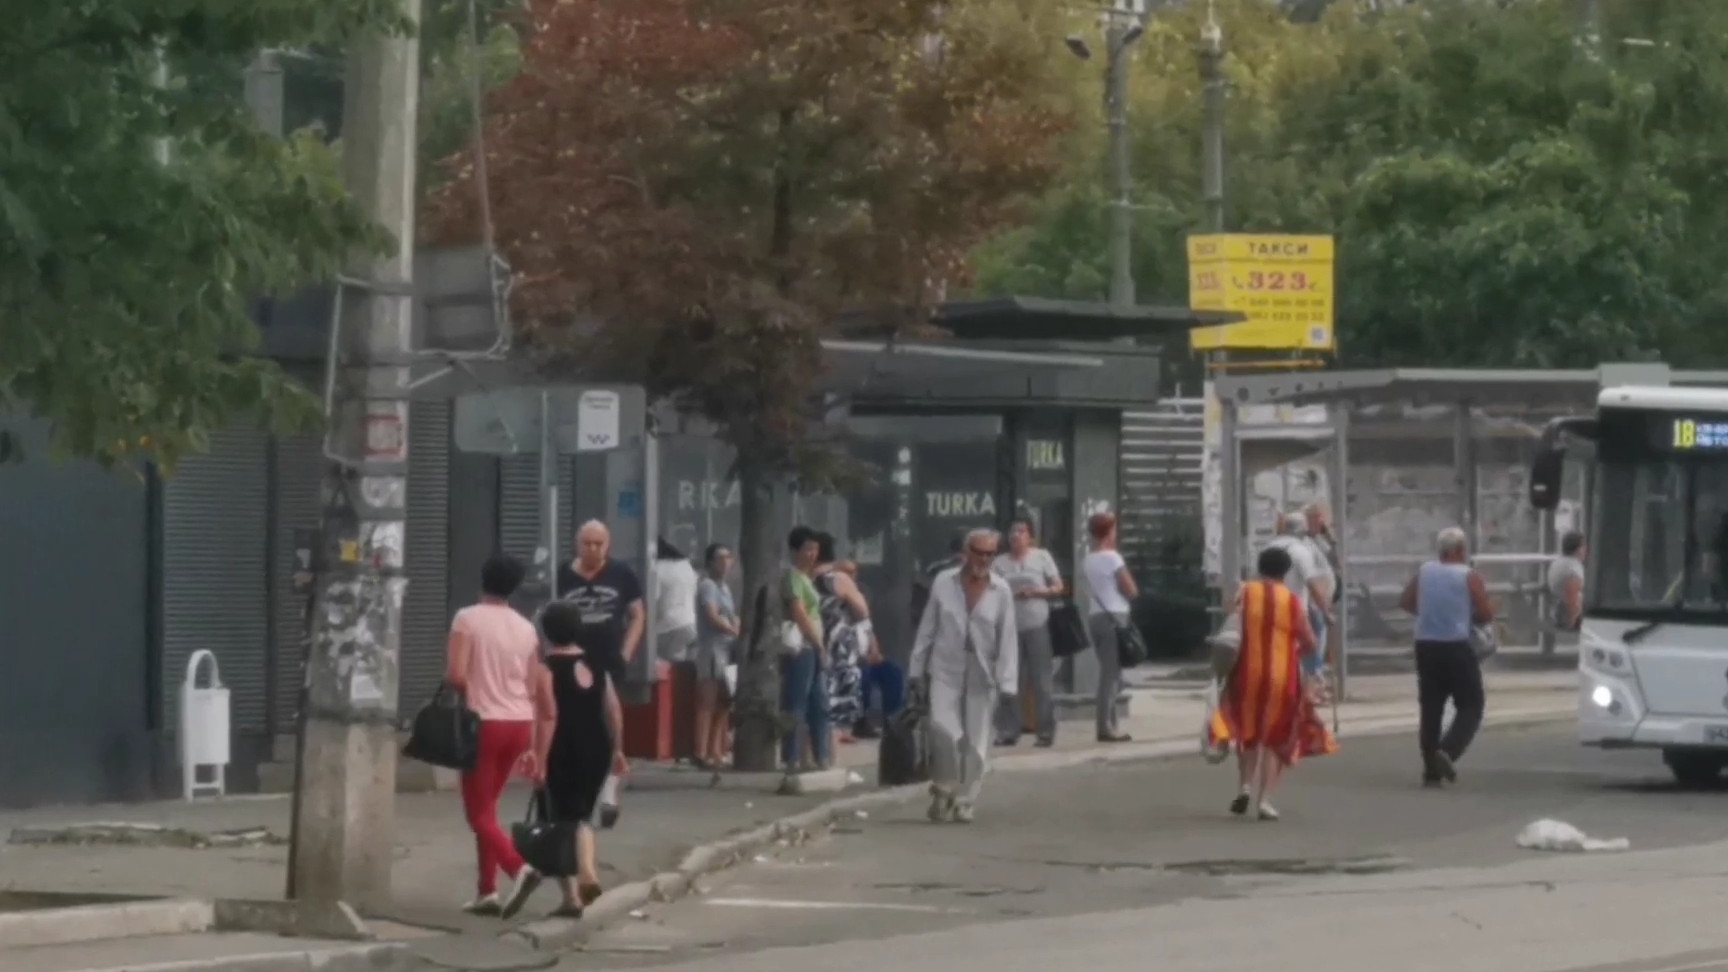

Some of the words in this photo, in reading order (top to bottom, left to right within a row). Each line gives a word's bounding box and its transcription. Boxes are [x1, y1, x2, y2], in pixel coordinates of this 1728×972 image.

[1249, 238, 1309, 255] ТАКСИ
[1248, 271, 1306, 291] 323
[1674, 419, 1695, 448] 18
[1026, 439, 1065, 469] TURKA
[926, 490, 996, 516] TURKA
